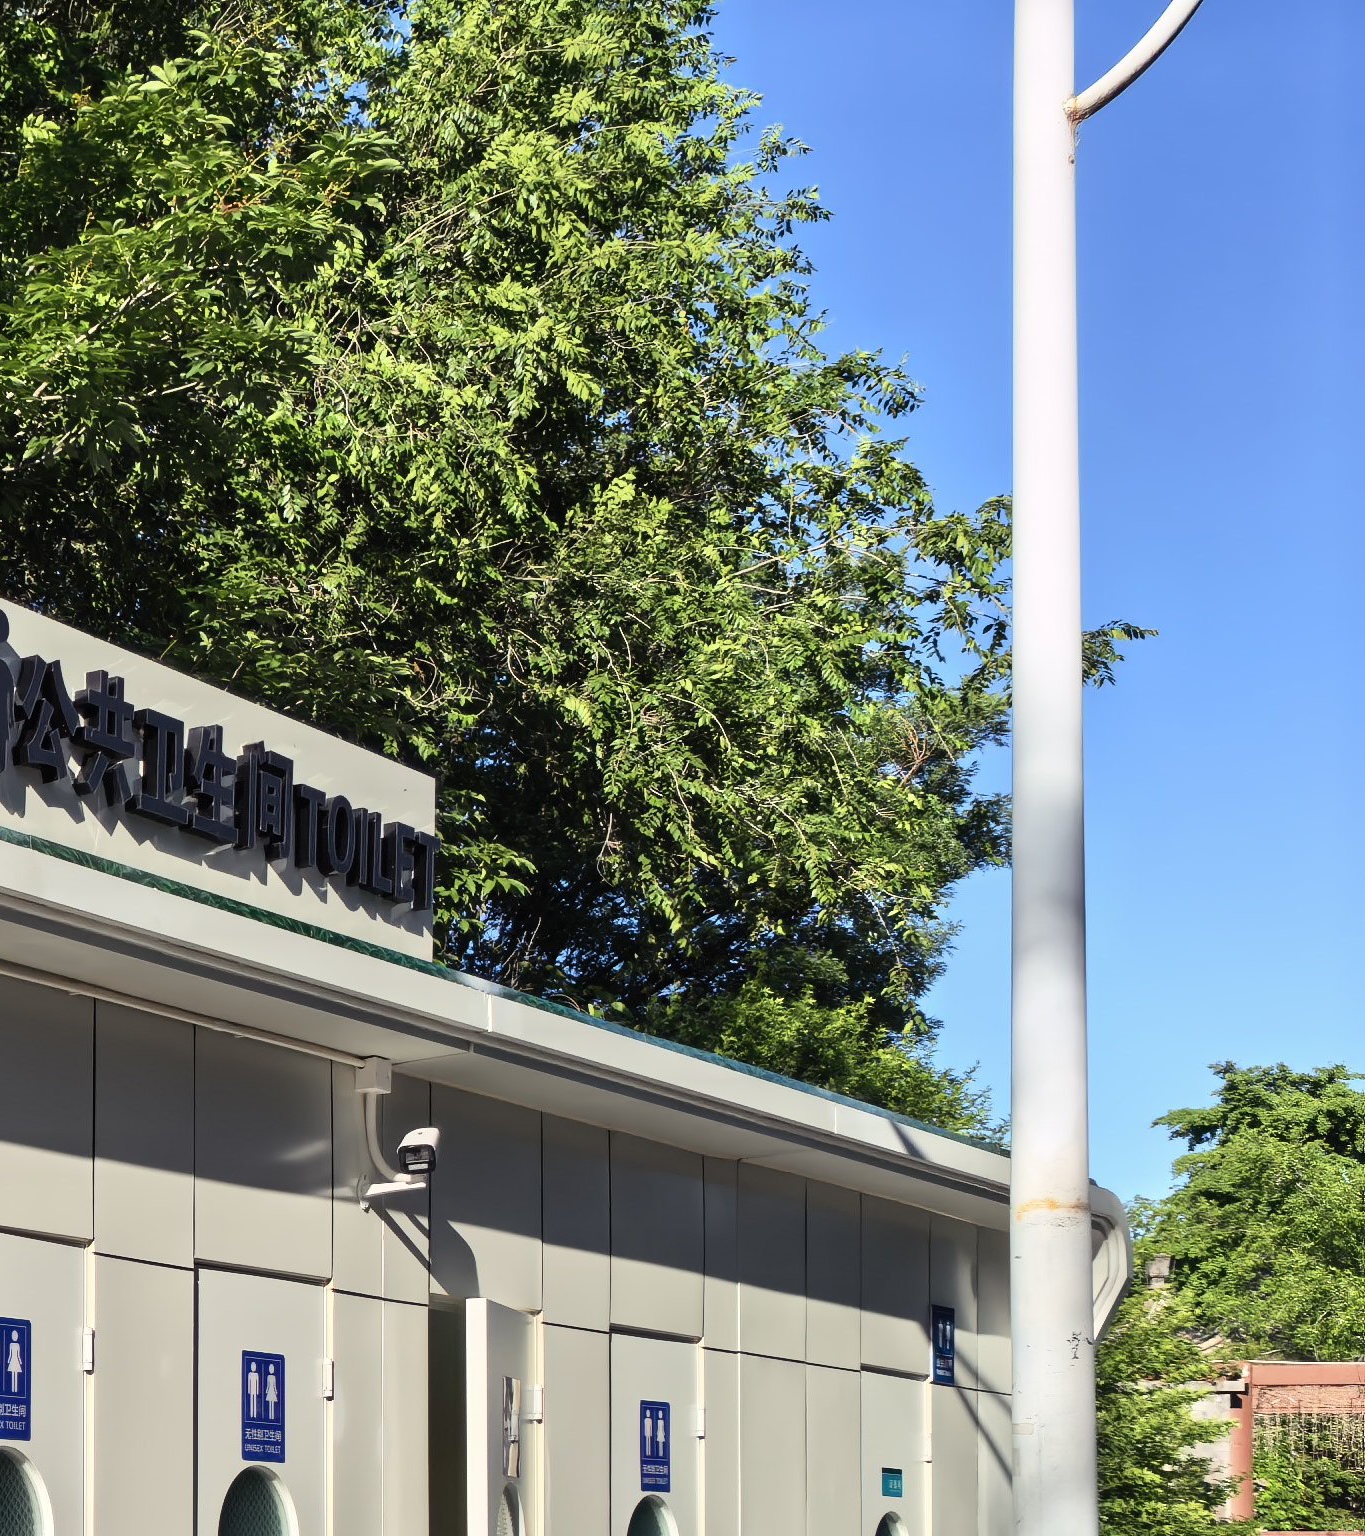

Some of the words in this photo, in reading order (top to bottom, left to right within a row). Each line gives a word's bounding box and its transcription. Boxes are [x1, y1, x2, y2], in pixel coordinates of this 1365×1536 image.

[12, 653, 294, 862] 公共卫生间
[293, 783, 441, 911] TOILET
[6, 1421, 26, 1431] TOILET
